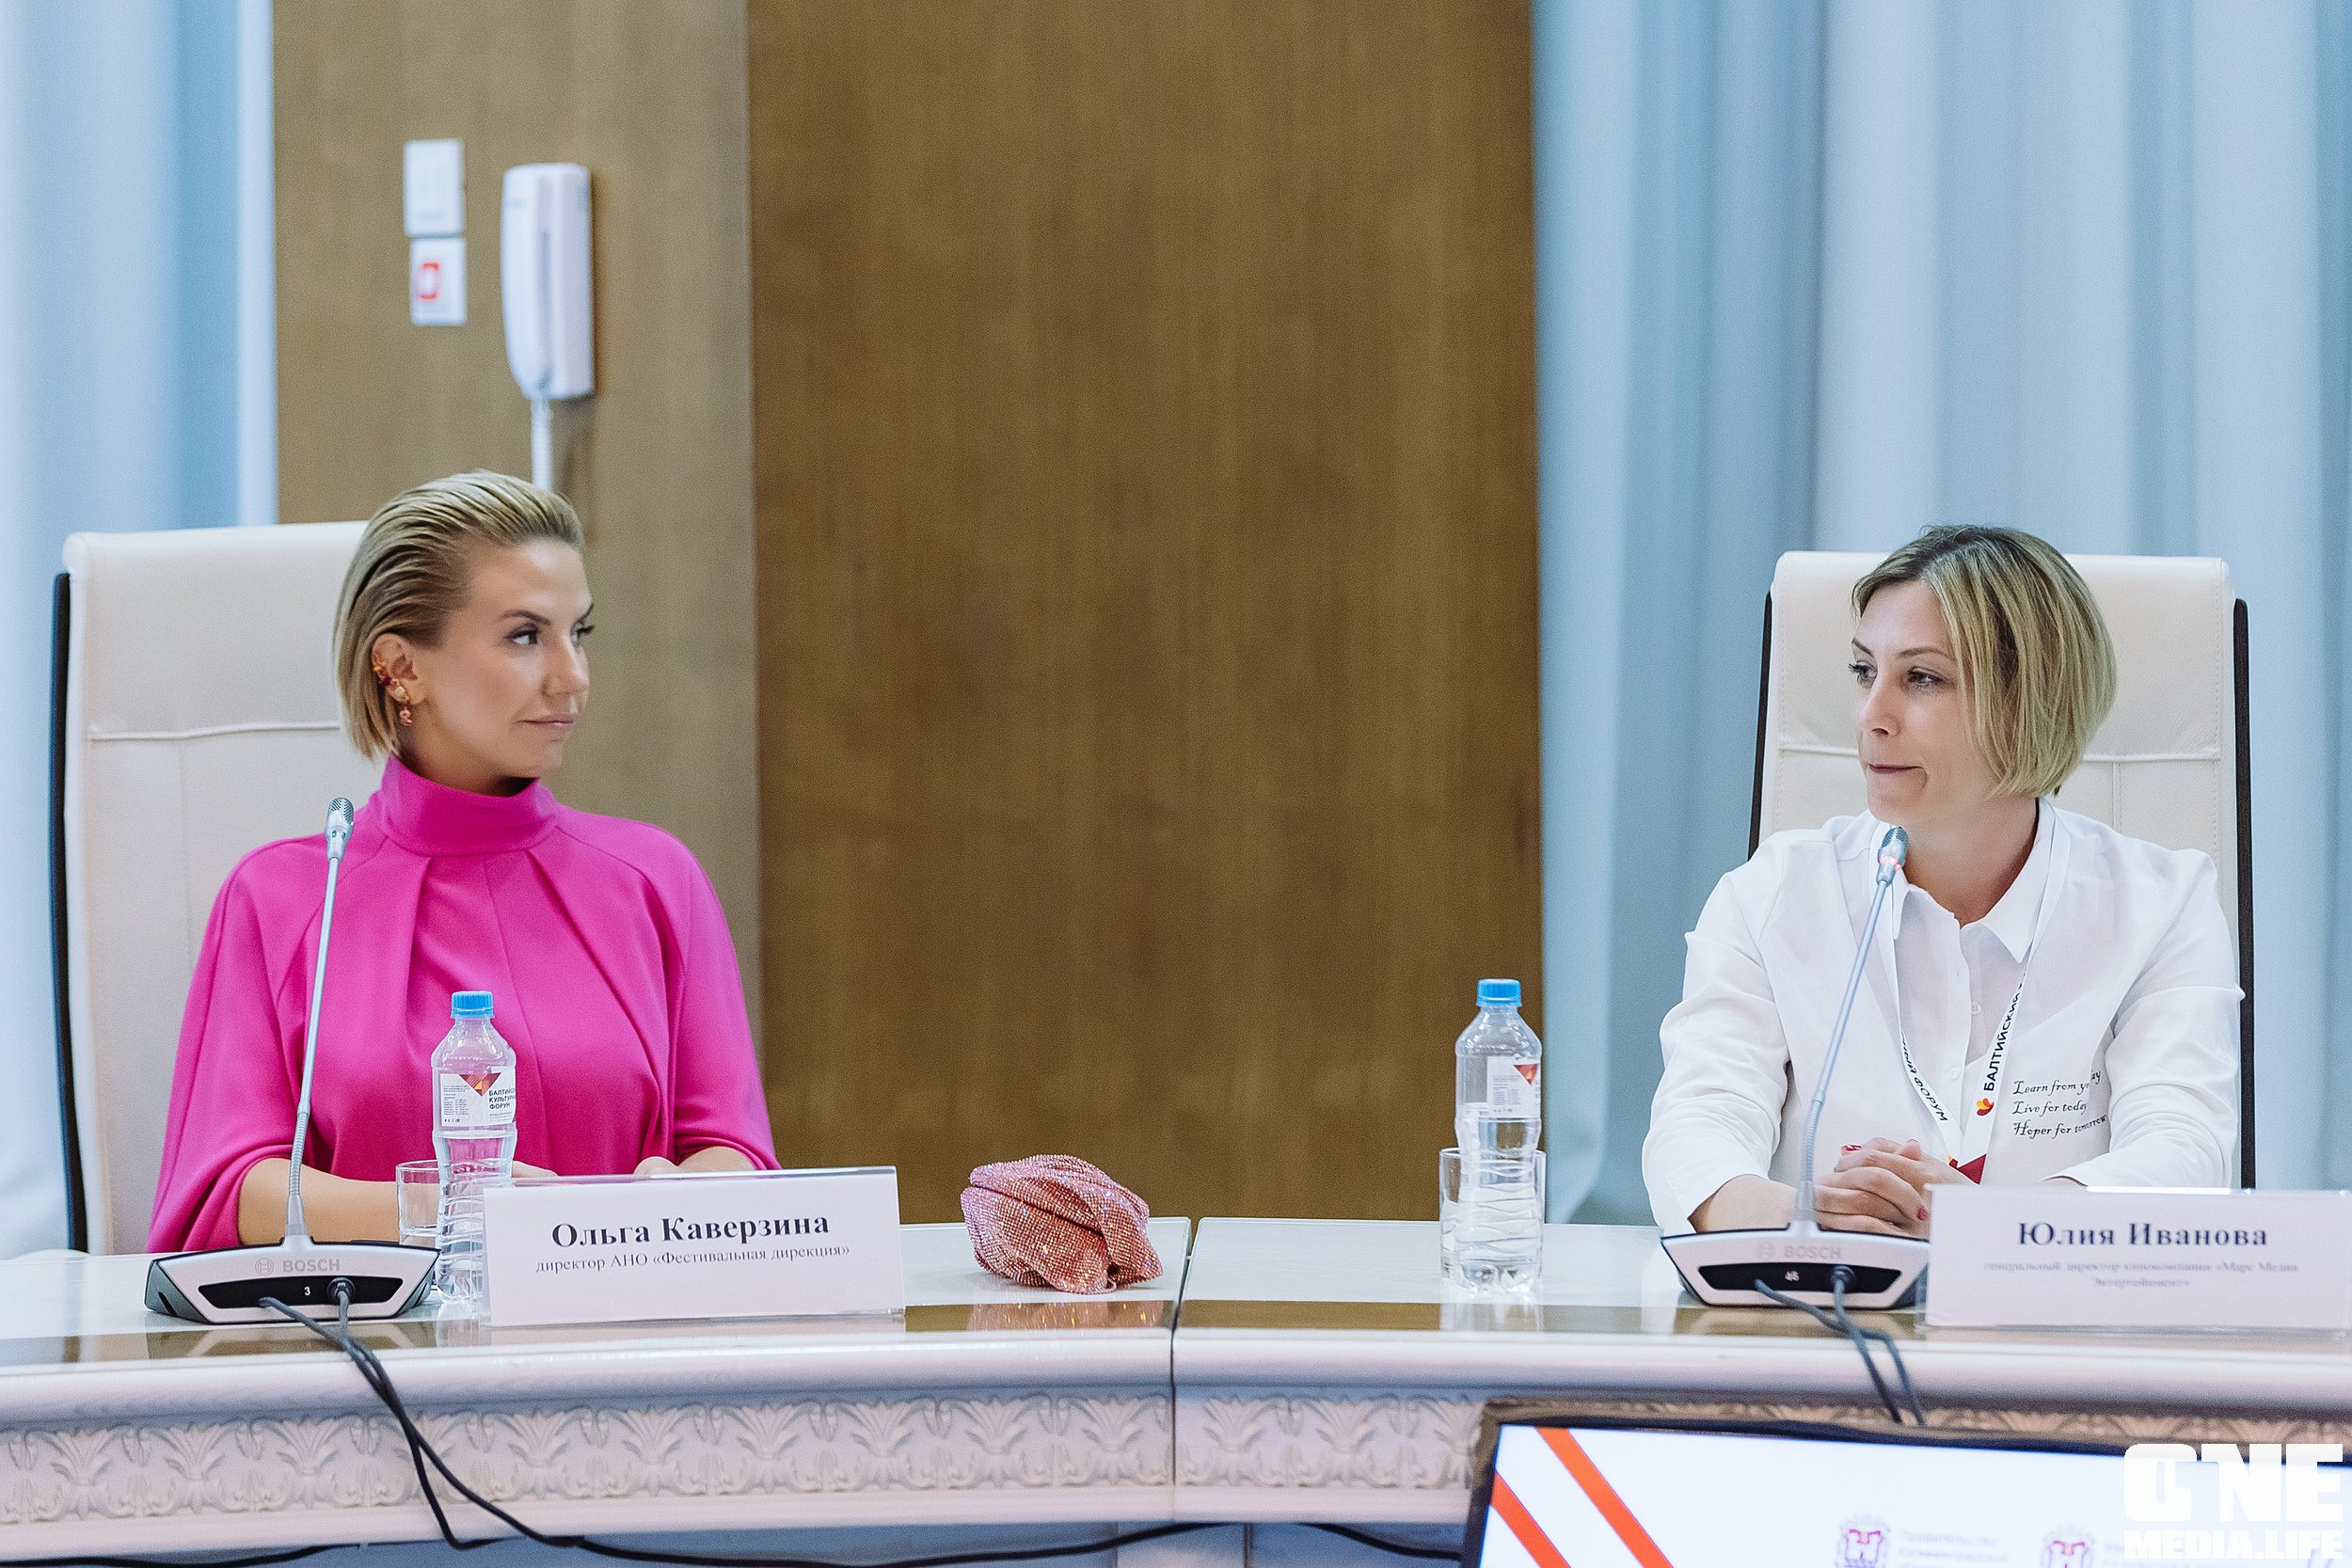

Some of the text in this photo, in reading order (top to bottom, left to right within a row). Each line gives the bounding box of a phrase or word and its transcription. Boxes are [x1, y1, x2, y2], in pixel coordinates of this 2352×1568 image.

[2012, 1080, 2048, 1095] Learn
[2047, 1079, 2076, 1096] from
[1914, 1077, 1948, 1121] ФОРУМ
[2011, 1101, 2041, 1115] Live
[2039, 1101, 2060, 1117] for
[2012, 1118, 2053, 1140] Hoper
[2051, 1122, 2072, 1140] for
[550, 1213, 831, 1249] Ольга Каверзина
[2017, 1222, 2268, 1246] Юлия Иванова
[535, 1244, 850, 1274] директор АНО «Фестивальная дирекция»
[1783, 1244, 1842, 1259] BOSCH
[282, 1259, 341, 1273] BOSCH
[304, 1286, 311, 1296] 3
